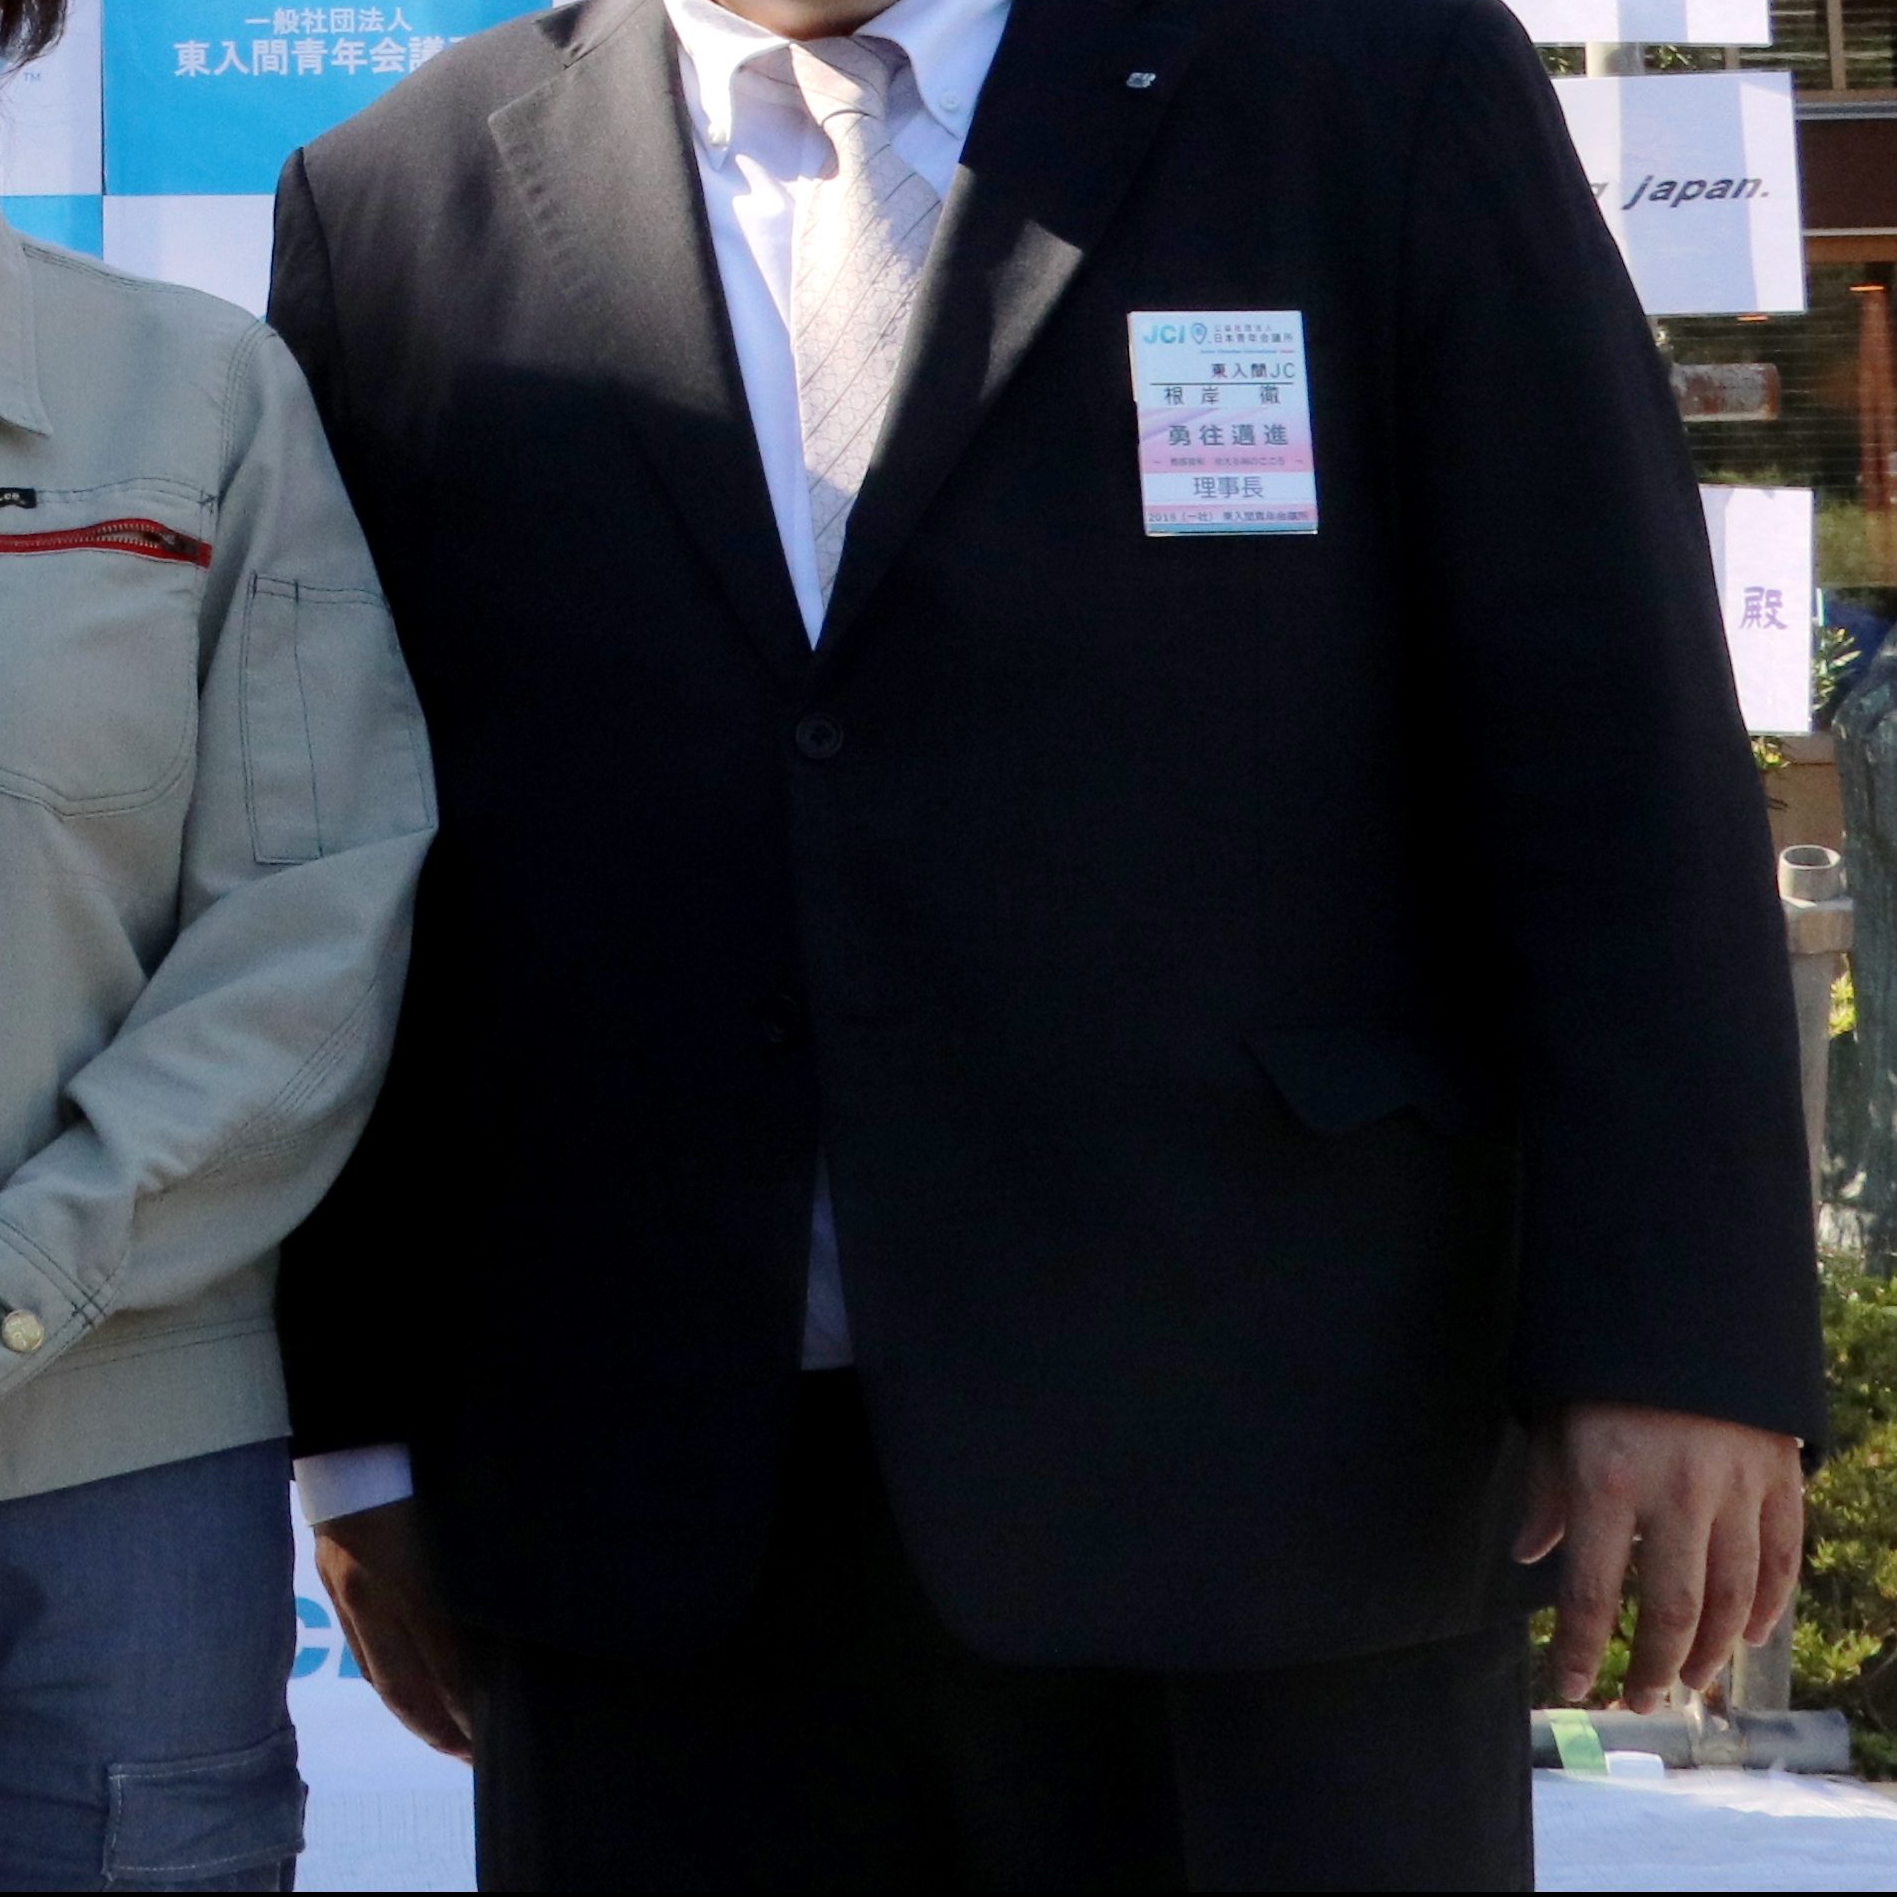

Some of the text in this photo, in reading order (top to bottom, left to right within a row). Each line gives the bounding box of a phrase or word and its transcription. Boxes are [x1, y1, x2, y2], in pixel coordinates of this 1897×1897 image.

[244, 6, 414, 35] 一般社団法人
[173, 36, 466, 78] 東入間青年会議
[1192, 475, 1265, 499] 理事長
[1739, 585, 1789, 632] 殿
